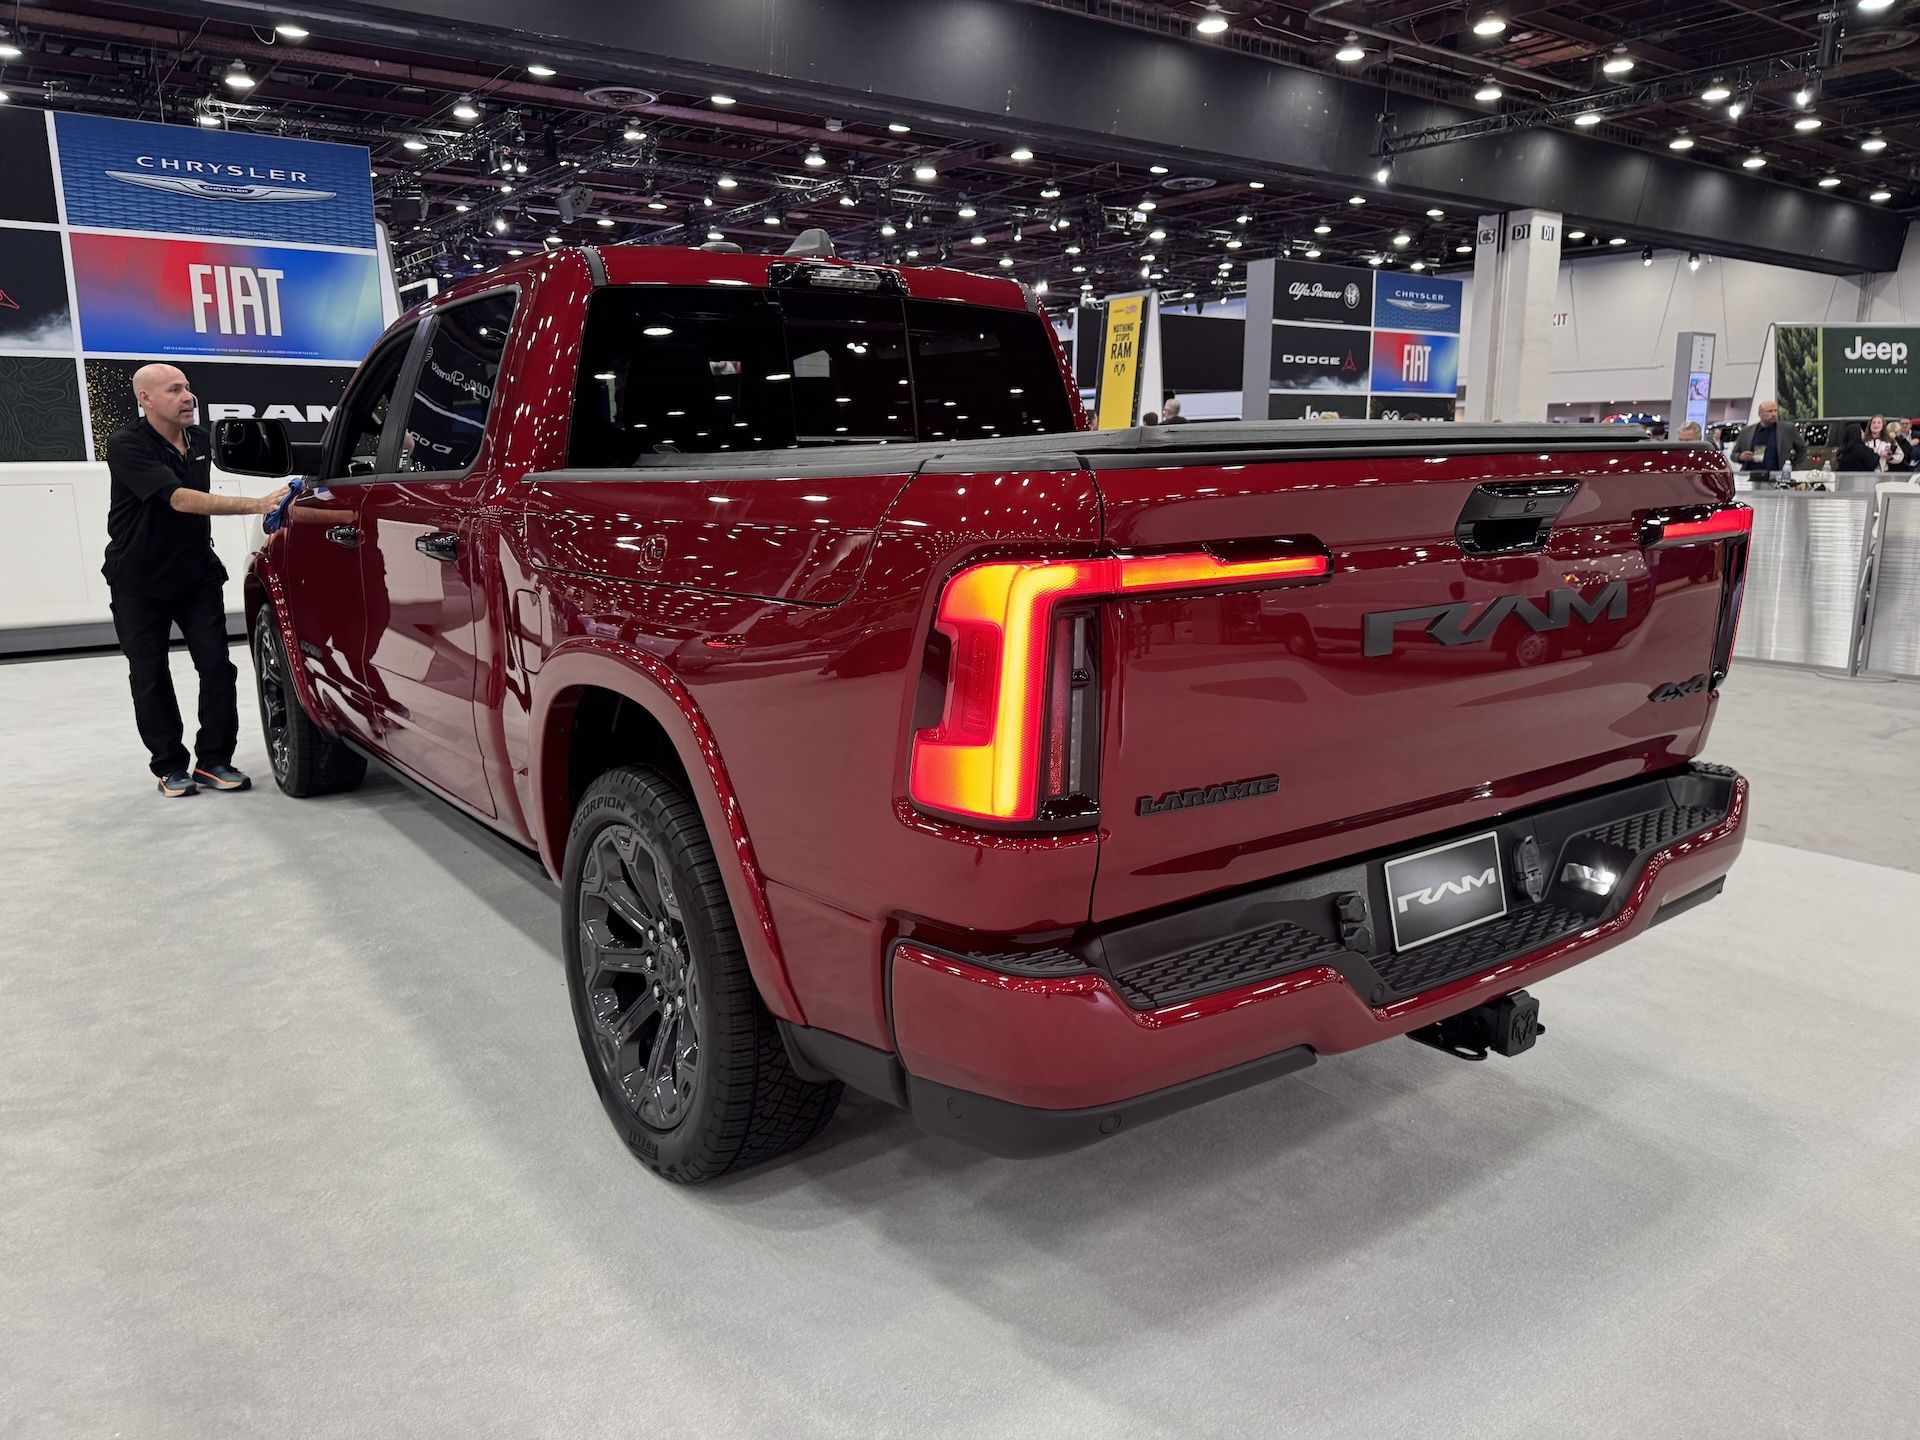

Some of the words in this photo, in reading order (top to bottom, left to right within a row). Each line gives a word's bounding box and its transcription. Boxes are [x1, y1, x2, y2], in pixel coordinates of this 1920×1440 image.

[136, 156, 307, 183] CHRYSLER
[1480, 230, 1495, 244] C3
[1514, 224, 1529, 239] D1
[1543, 225, 1553, 240] D1
[189, 264, 284, 336] FIAT
[1288, 282, 1311, 300] Alfa
[1310, 283, 1342, 299] Romeo
[1395, 289, 1444, 301] CHRYSLER
[1110, 341, 1132, 359] RAM
[1282, 353, 1341, 366] DODGE
[1844, 335, 1908, 365] Jeep
[1402, 344, 1432, 382] FIAT
[1874, 367, 1893, 375] ONLY
[1894, 367, 1908, 375] ONE
[1361, 581, 1628, 658] RAM
[1135, 773, 1280, 816] LARAMIE
[572, 795, 626, 838] SCORPION
[1397, 867, 1496, 914] RAM
